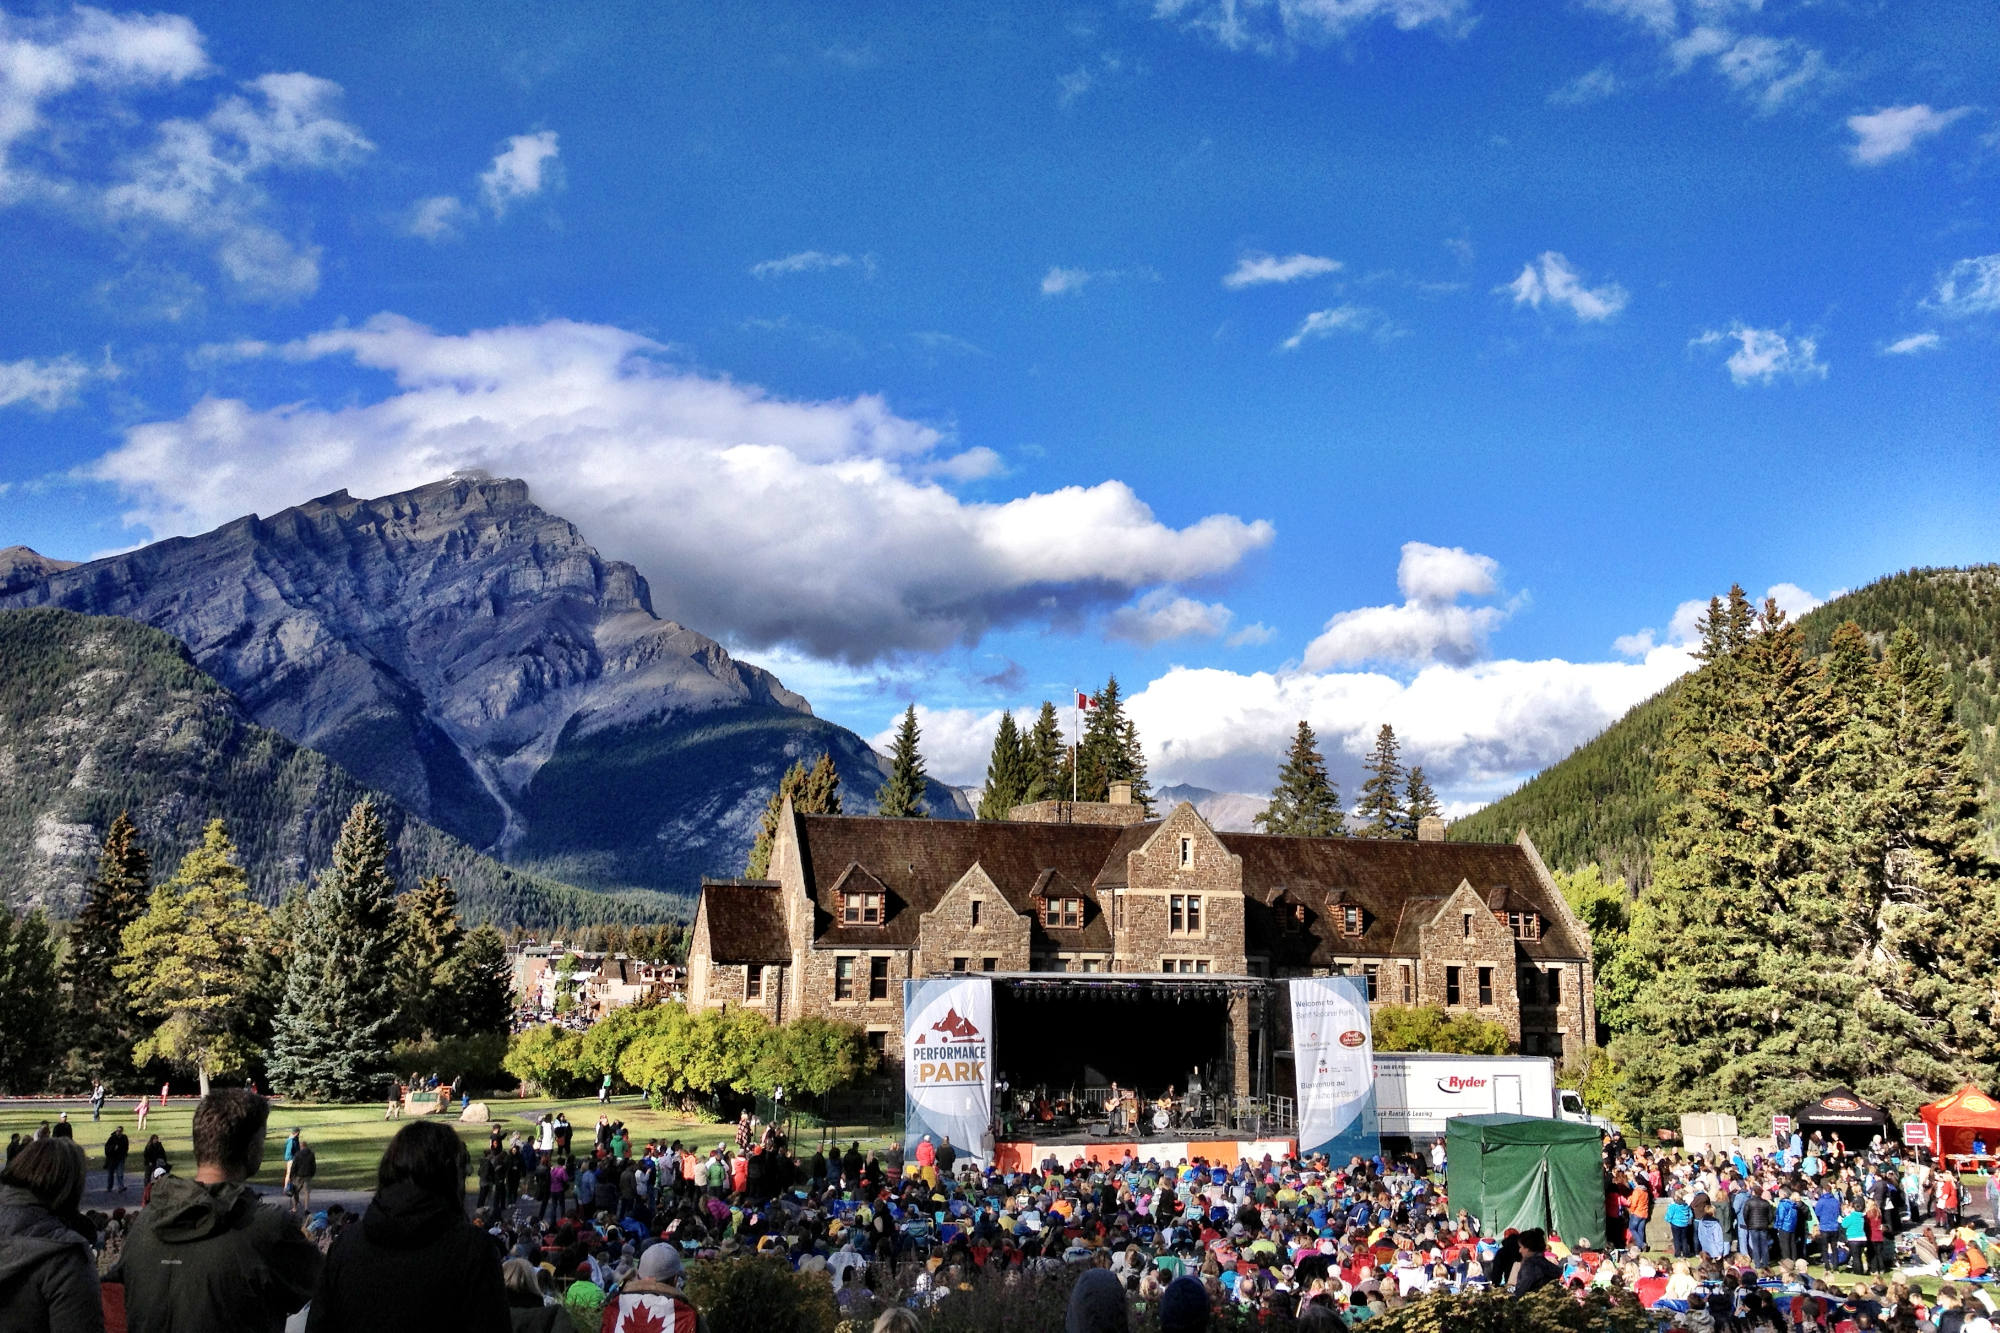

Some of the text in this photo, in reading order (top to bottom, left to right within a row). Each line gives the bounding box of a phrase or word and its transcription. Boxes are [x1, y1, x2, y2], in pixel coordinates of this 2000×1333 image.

[1295, 1000, 1325, 1008] Welcome
[913, 1046, 986, 1060] PERFORMANCE
[920, 1061, 986, 1082] PARK
[1449, 1076, 1487, 1090] Ryder
[1412, 1110, 1433, 1118] Leasing
